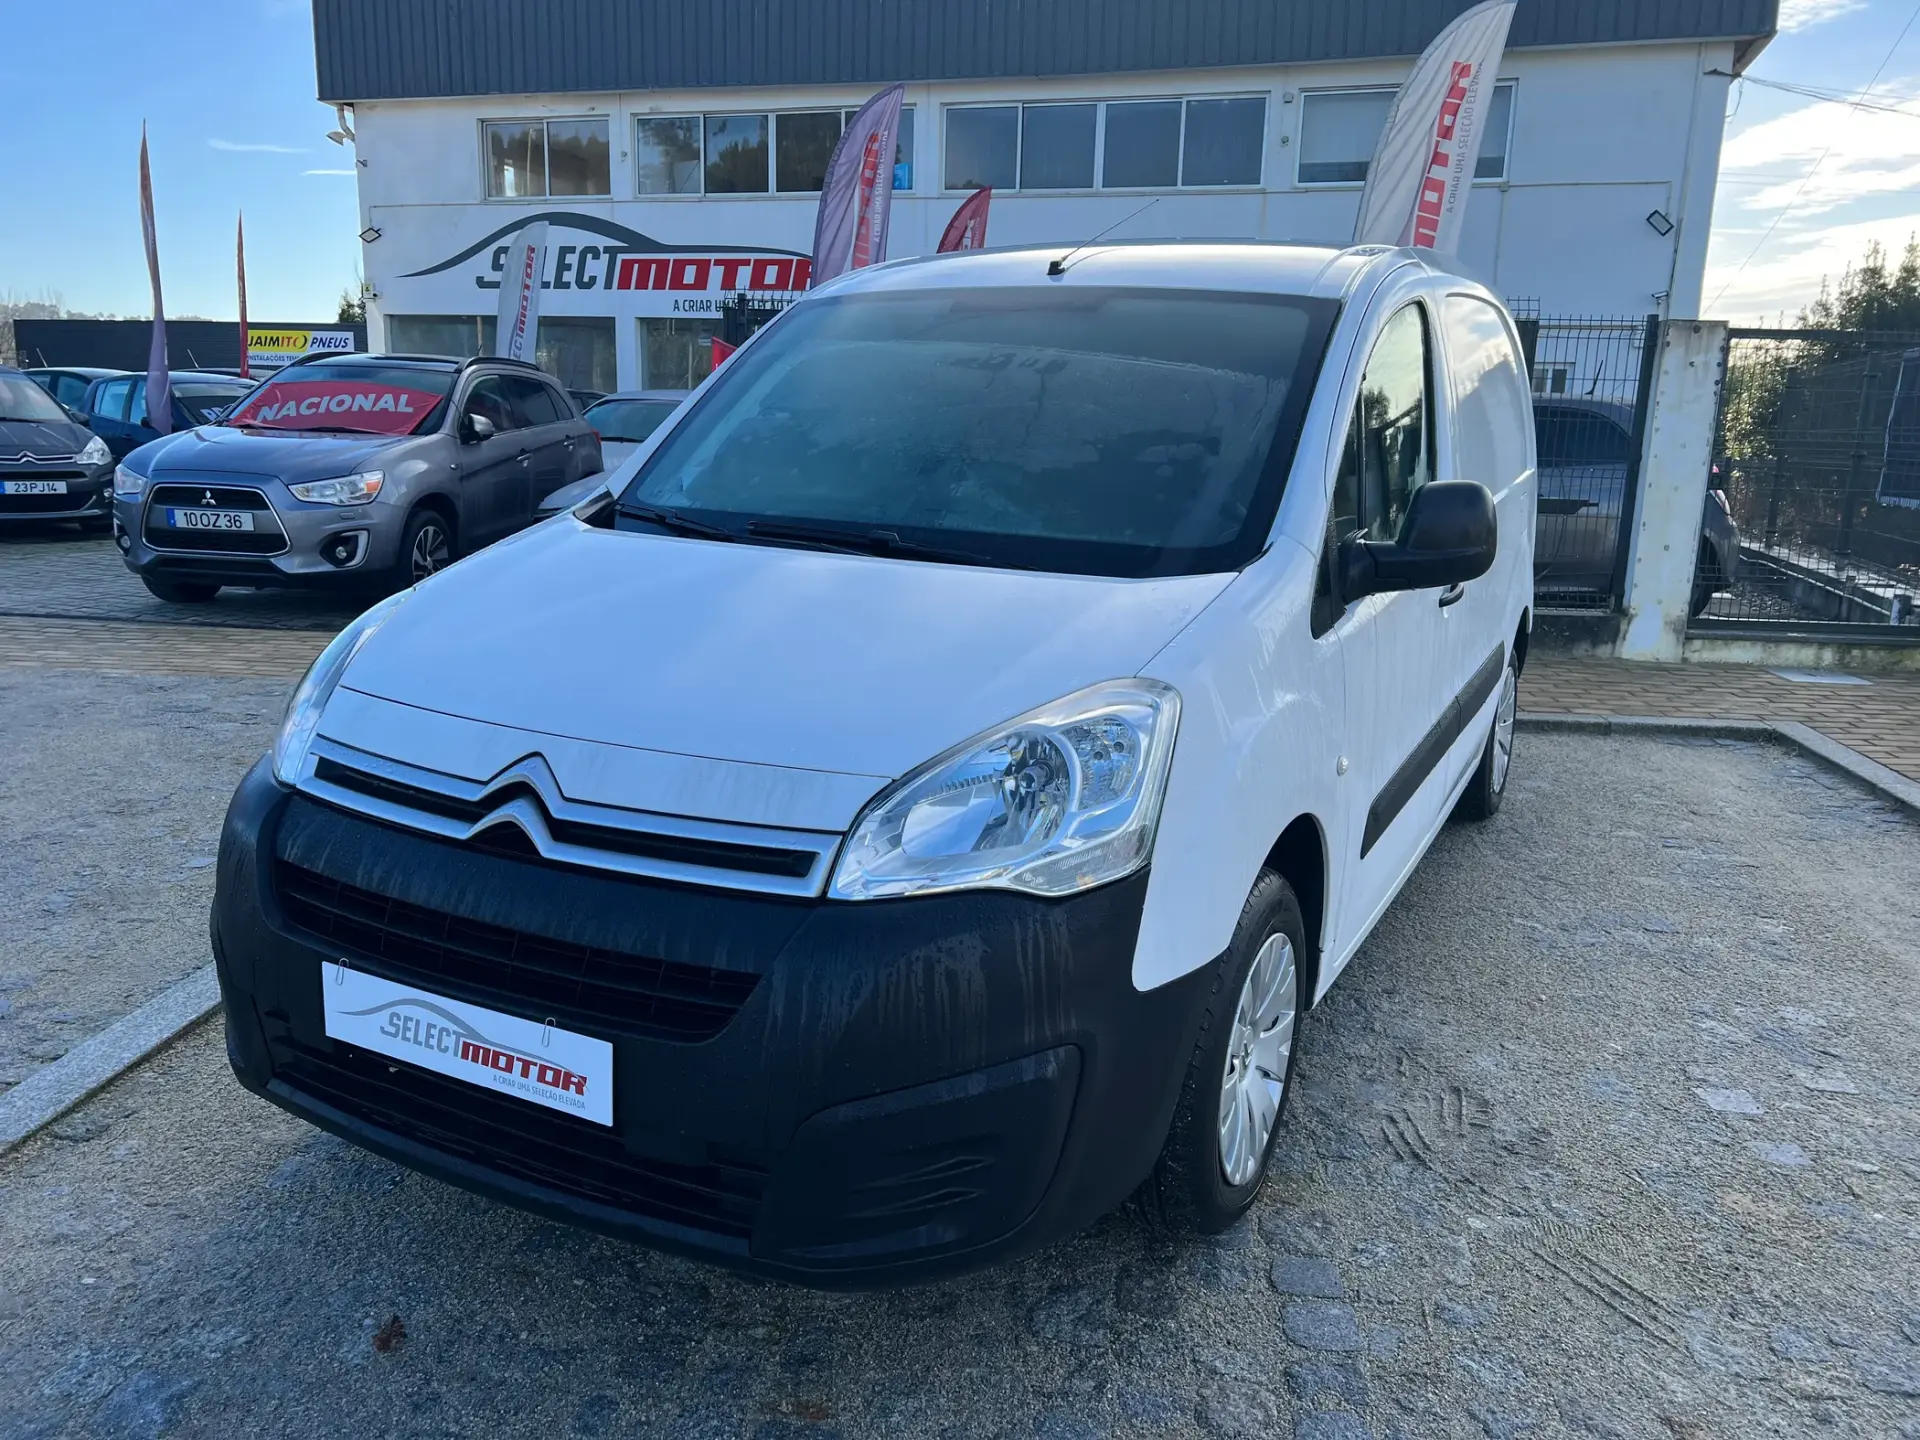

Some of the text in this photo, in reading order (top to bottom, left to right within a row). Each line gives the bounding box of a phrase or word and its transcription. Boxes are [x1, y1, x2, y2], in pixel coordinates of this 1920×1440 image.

[1458, 106, 1473, 151] SELEÇÃO
[1454, 152, 1466, 174] UMA
[1448, 175, 1461, 204] CRIAR
[673, 299, 680, 312] A
[683, 299, 712, 312] CRIAR
[310, 337, 349, 348] PNEUS
[256, 393, 414, 422] NACIONAL
[498, 1075, 516, 1090] CRIAR
[517, 1082, 531, 1093] UMA
[532, 1086, 558, 1102] SELEÇÃO
[558, 1094, 586, 1111] ELEVADA
